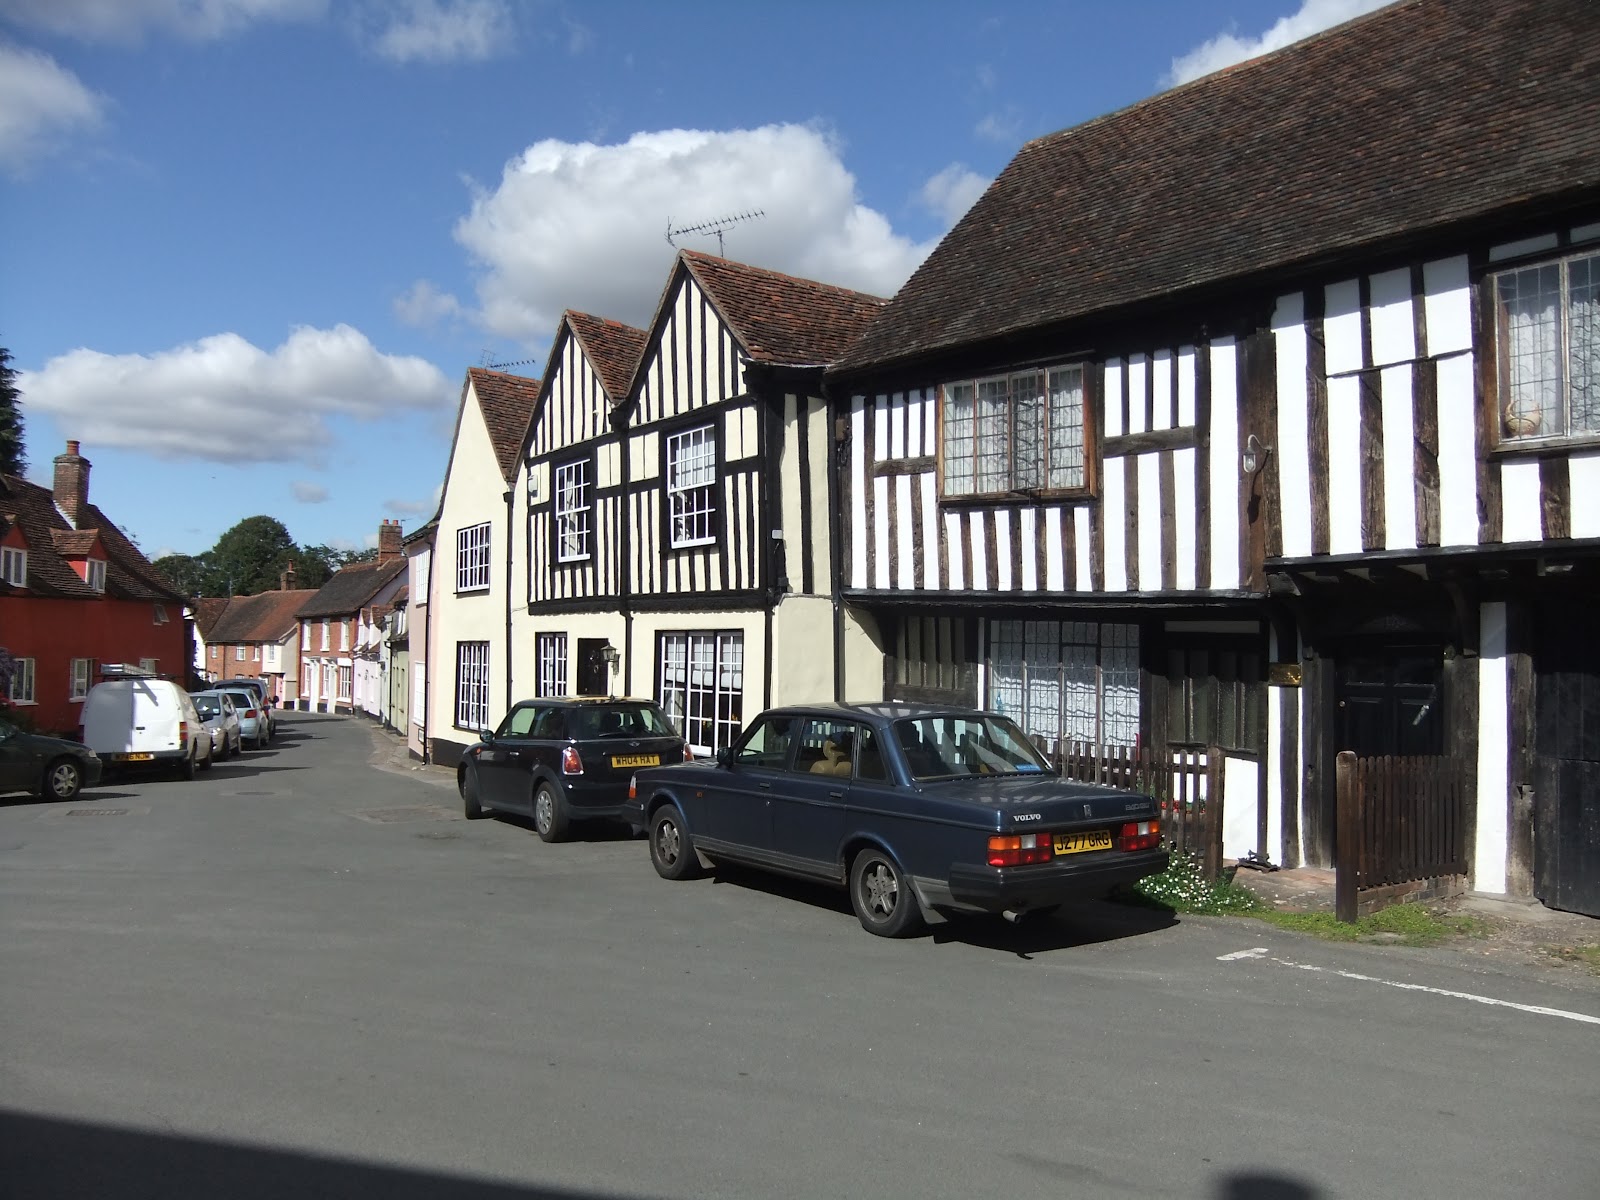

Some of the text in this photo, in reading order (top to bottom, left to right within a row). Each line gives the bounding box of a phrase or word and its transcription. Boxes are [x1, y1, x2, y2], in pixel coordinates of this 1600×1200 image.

[640, 755, 655, 764] HAT
[1013, 813, 1041, 822] VOLVO
[1056, 832, 1110, 851] J277 GRG
